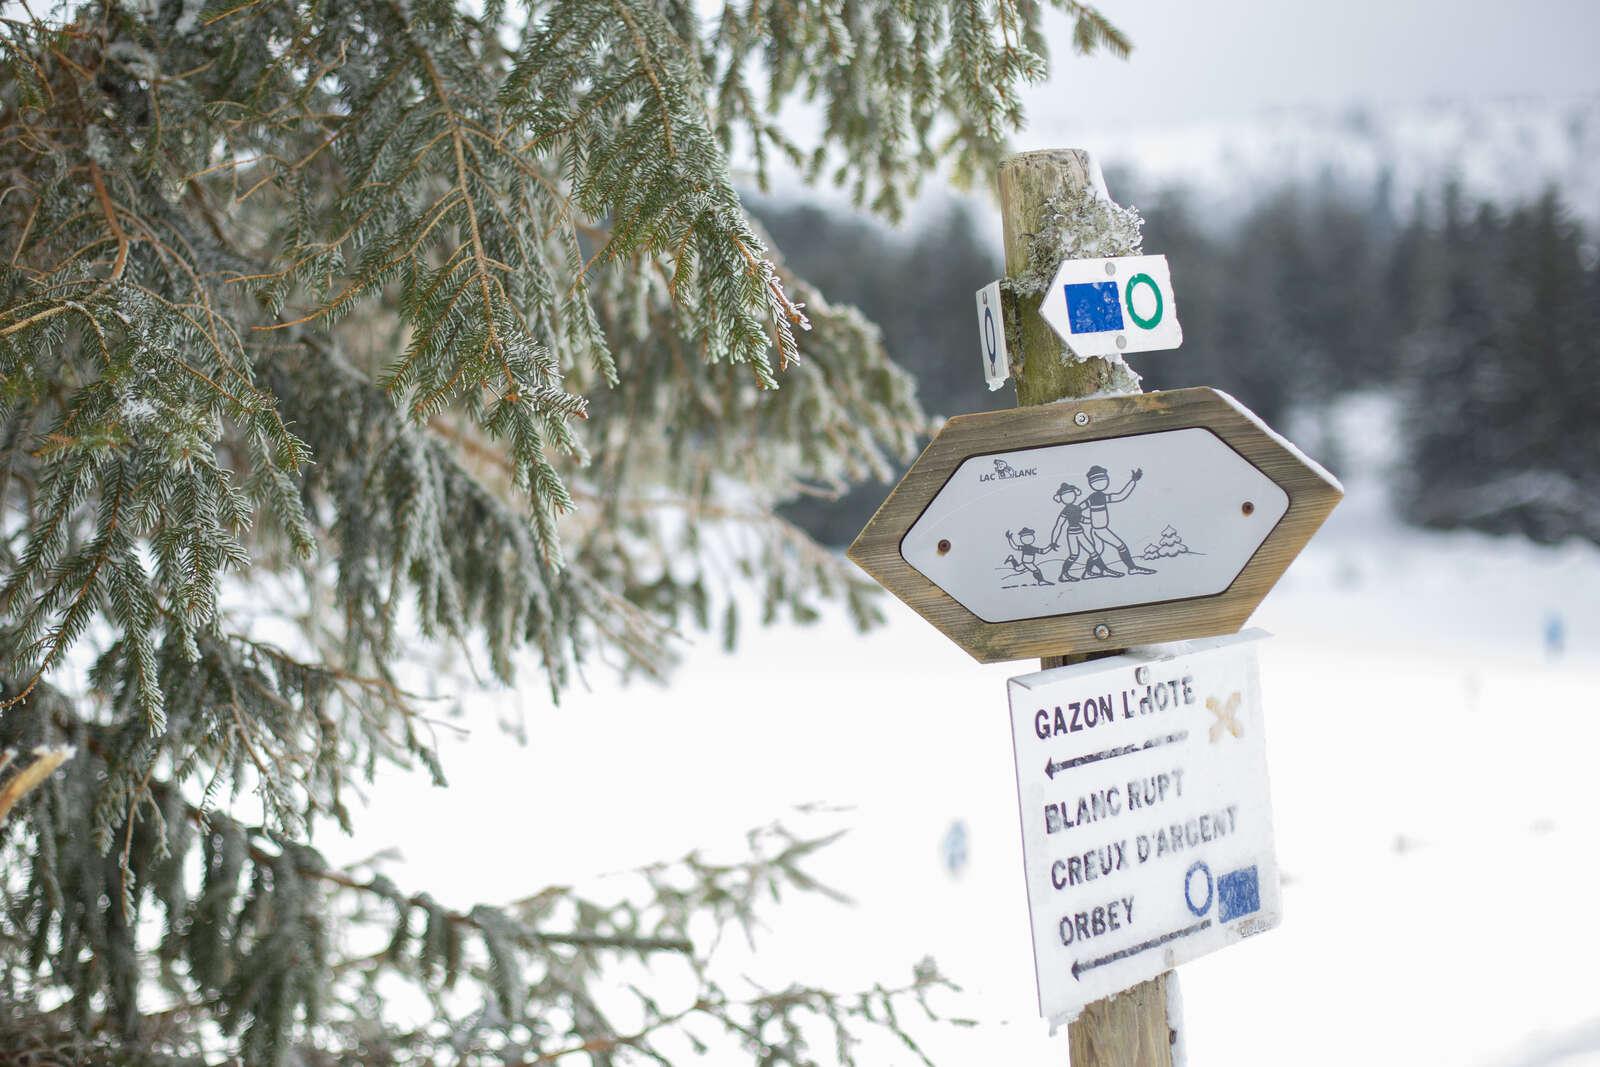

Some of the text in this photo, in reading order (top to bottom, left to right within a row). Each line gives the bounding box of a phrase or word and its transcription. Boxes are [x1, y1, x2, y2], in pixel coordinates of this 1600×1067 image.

[979, 473, 996, 482] LAC
[1034, 694, 1115, 740] GAZON
[1044, 768, 1184, 835] BLANC RUPT
[1051, 805, 1239, 890] CREUX D'ARGENT
[1058, 895, 1135, 946] ORBEY
